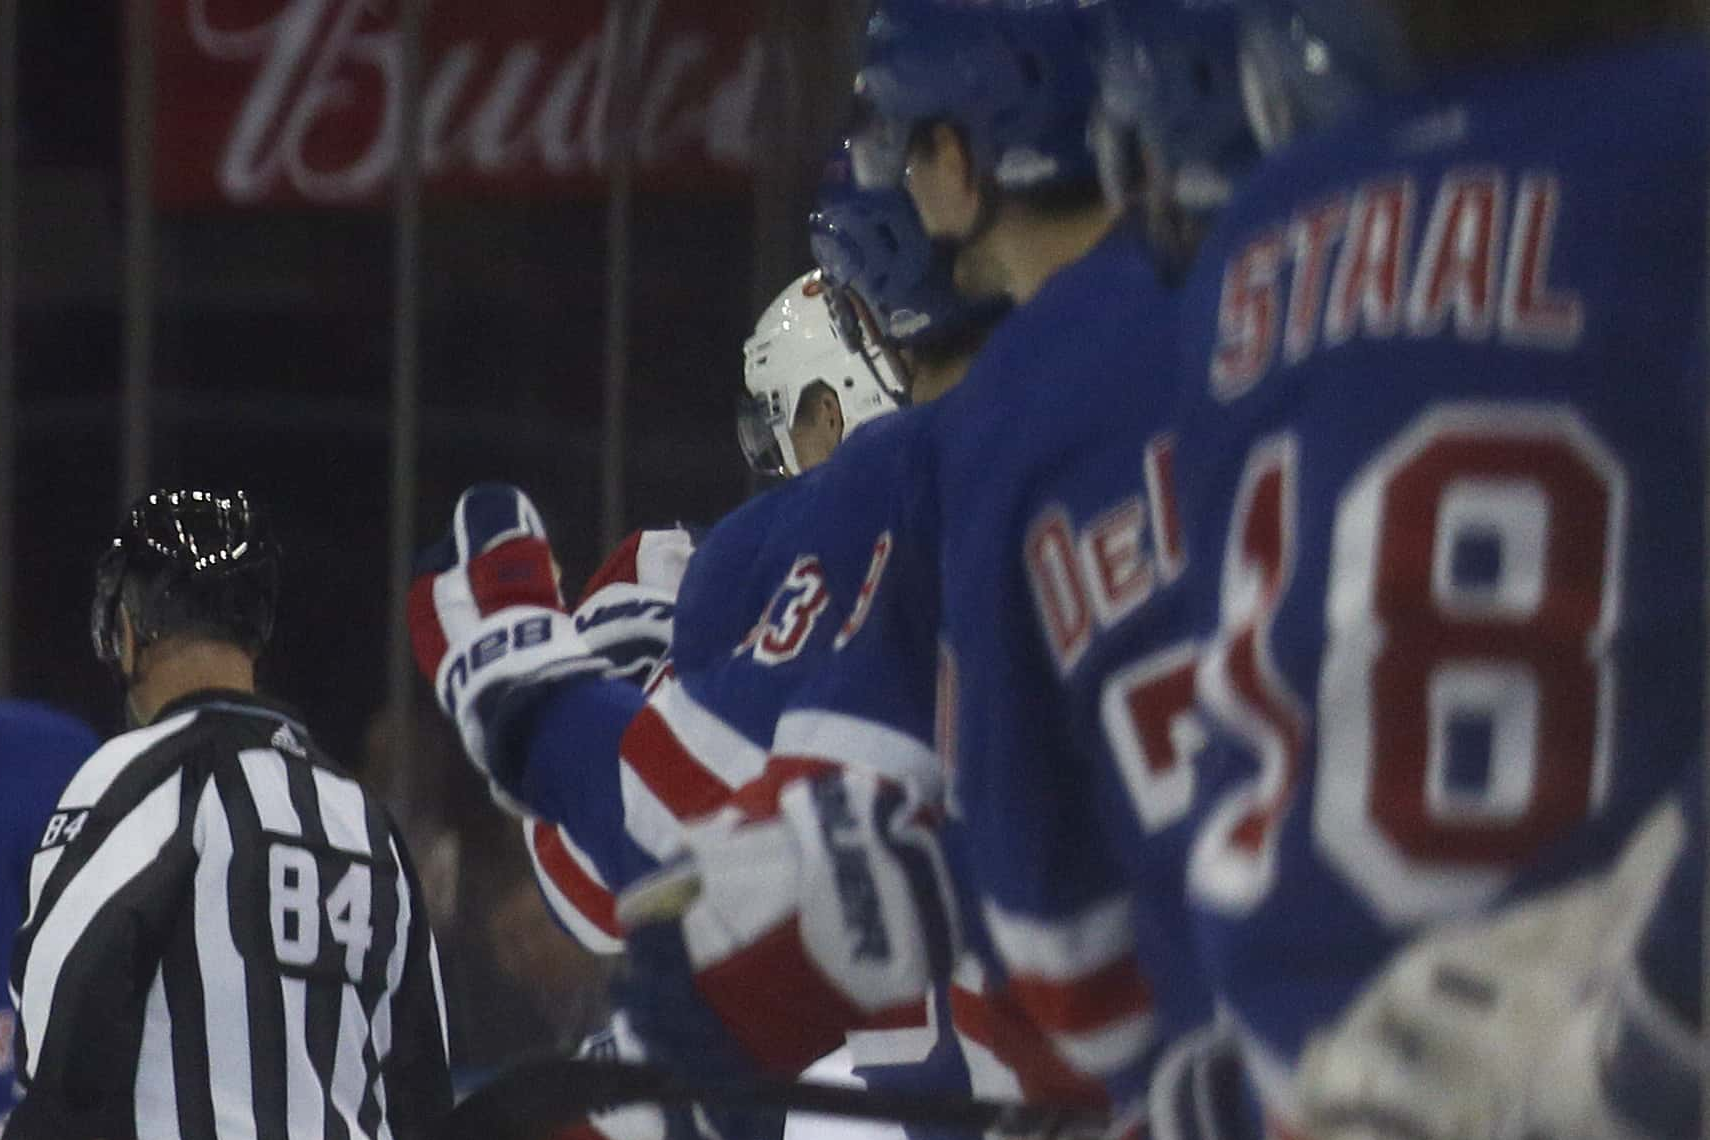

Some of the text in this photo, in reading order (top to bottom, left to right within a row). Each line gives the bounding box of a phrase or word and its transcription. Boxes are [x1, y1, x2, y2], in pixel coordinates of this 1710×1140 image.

[1208, 168, 1584, 402] STAAL
[41, 811, 89, 848] 84
[269, 842, 373, 984] 84
